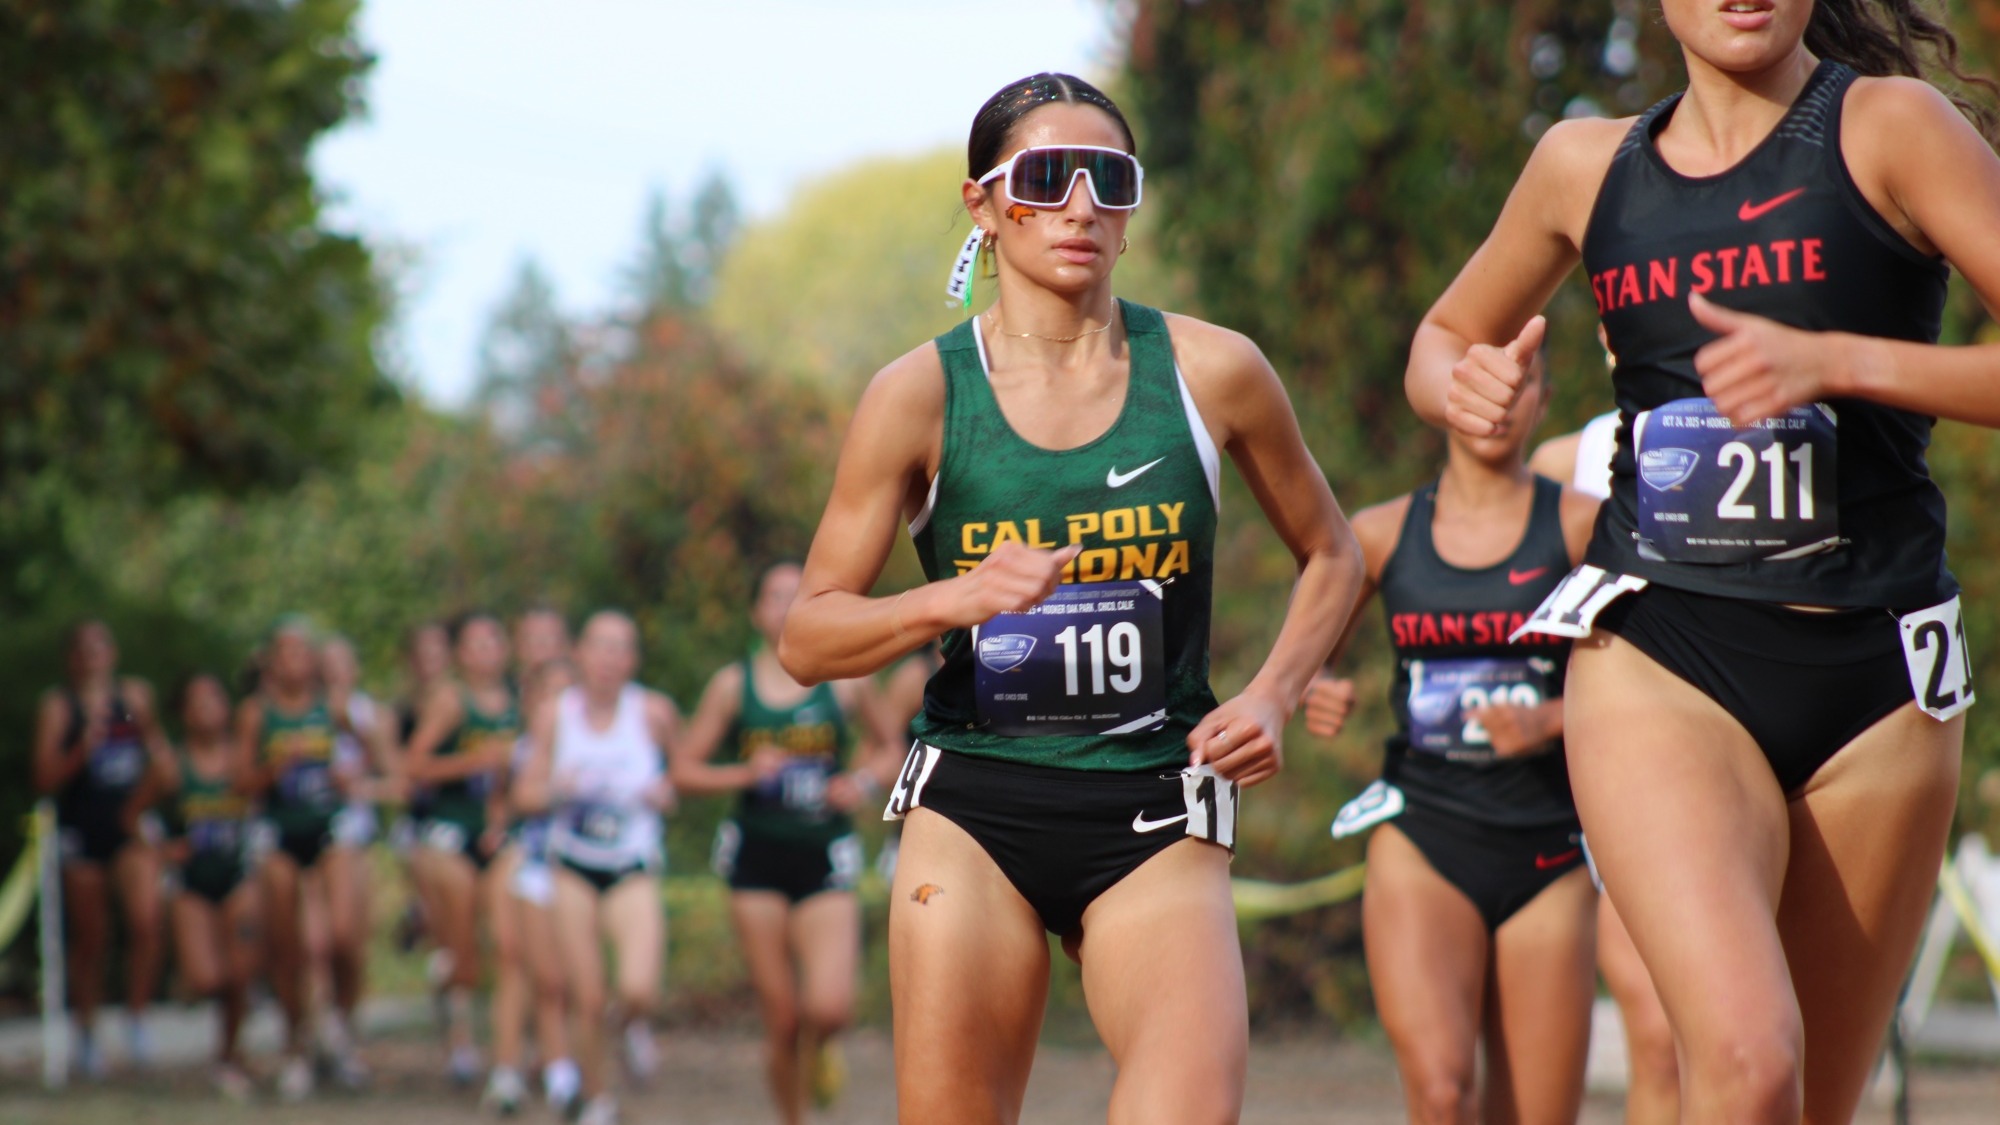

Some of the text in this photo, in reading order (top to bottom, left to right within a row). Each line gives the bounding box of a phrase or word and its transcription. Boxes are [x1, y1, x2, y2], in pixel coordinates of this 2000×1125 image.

[1592, 239, 1826, 316] STAN STATE
[1662, 415, 1674, 428] OCT
[1706, 416, 1731, 429] HOOKER
[1717, 441, 1814, 520] 211
[962, 502, 1185, 554] CAL POLY
[953, 540, 1190, 585] ONA
[1042, 604, 1066, 615] HOOKER
[1066, 603, 1079, 614] OAK
[1392, 610, 1563, 647] STAN STA
[1054, 621, 1142, 696] 119
